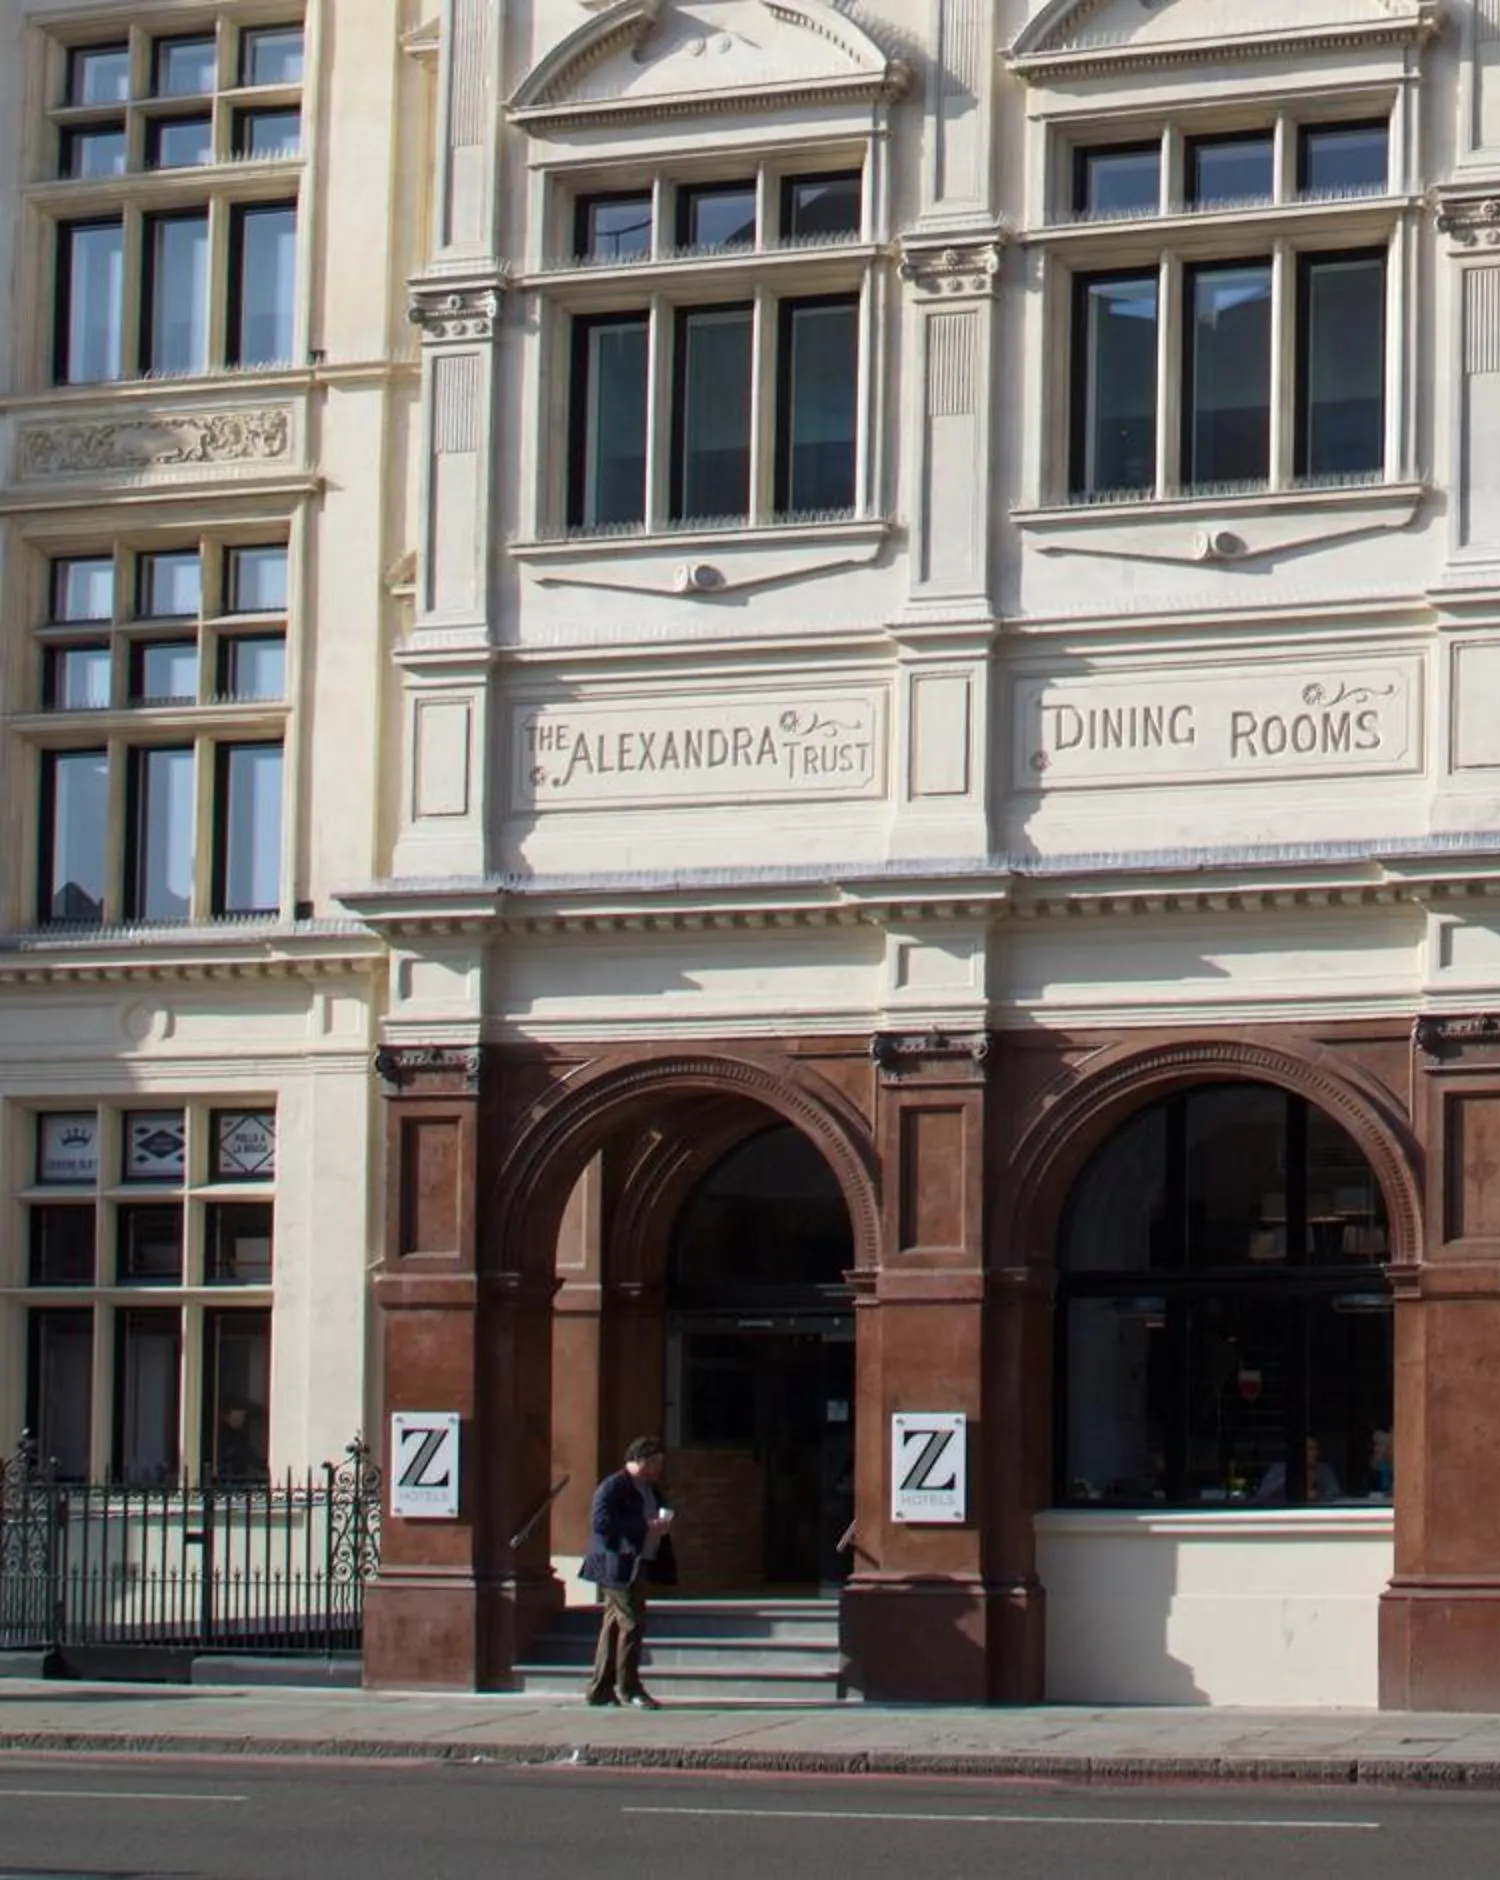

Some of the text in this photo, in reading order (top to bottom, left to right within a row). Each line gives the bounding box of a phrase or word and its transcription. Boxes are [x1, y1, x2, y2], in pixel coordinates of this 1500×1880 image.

[526, 724, 871, 787] THE ALEXANDRA TRUST
[1040, 704, 1382, 759] DINING ROOMS
[398, 1428, 449, 1487] Z
[900, 1430, 957, 1491] Z
[901, 1494, 957, 1507] HOTELS
